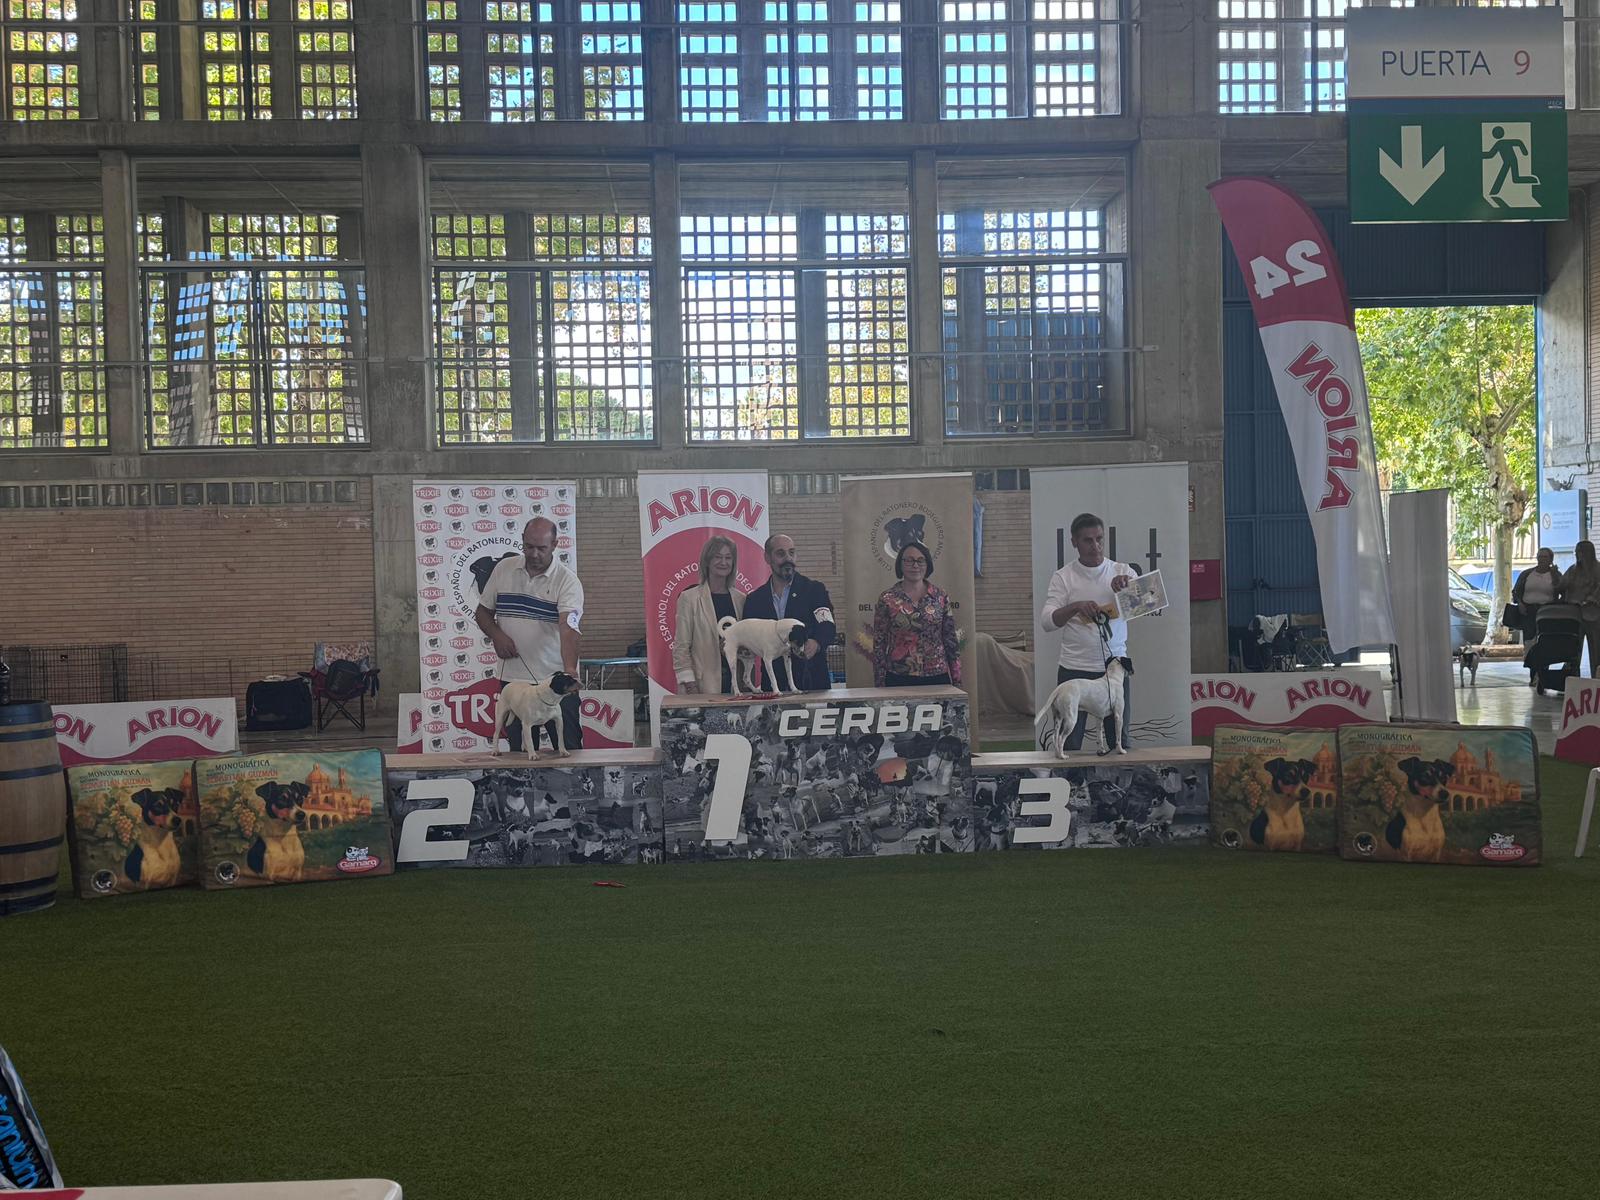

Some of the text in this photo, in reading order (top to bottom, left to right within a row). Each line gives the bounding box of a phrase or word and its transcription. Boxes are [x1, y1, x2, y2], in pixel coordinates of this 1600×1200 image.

[1382, 49, 1531, 77] PUERTA 9
[647, 486, 764, 536] ARION
[456, 553, 470, 567] DEL
[467, 537, 511, 554] RATONERO
[512, 540, 525, 551] BO
[662, 580, 678, 597] DEL
[674, 562, 699, 581] RATO
[461, 604, 476, 619] LUB
[858, 603, 873, 612] DEL
[1191, 680, 1257, 711] RION
[1285, 677, 1372, 712] ARION
[127, 705, 224, 746] ARION
[778, 704, 943, 737] CERBA
[88, 768, 142, 778] MONOGRÁFICA
[215, 759, 271, 772] MONOGRÁFICA
[704, 734, 753, 840] 1
[396, 778, 476, 863] 2
[1013, 777, 1071, 844] 3
